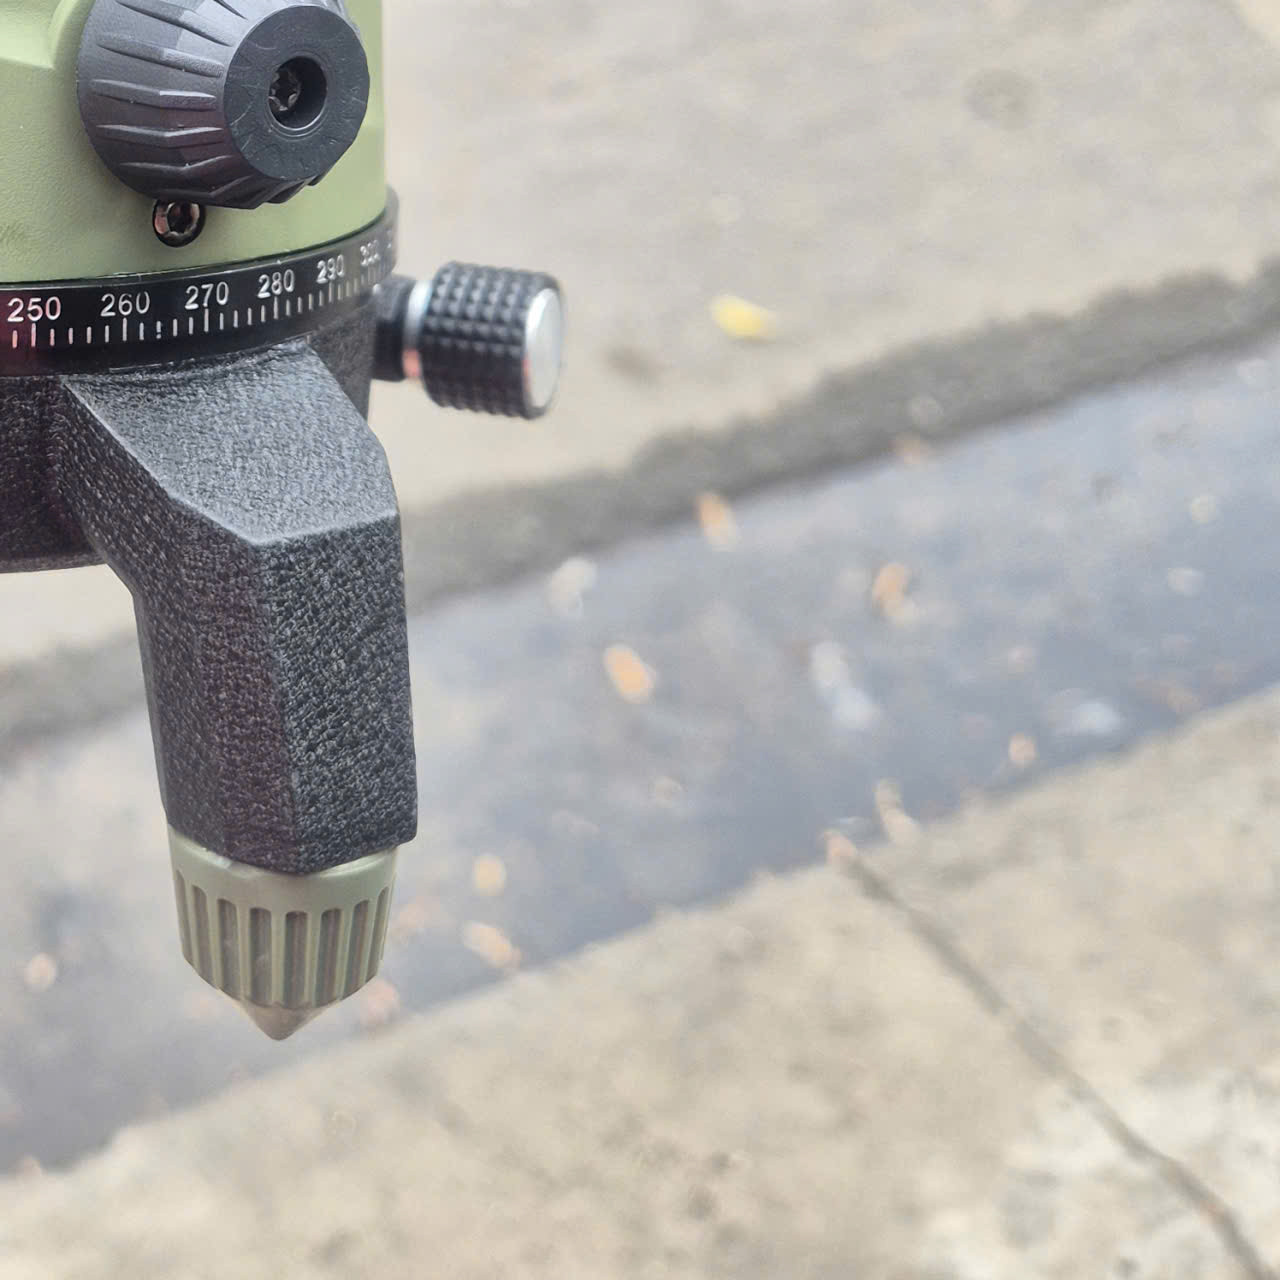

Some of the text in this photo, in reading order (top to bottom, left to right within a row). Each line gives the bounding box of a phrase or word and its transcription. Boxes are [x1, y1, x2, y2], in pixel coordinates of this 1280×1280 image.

[7, 295, 62, 324] 250
[100, 291, 151, 317] 260
[184, 281, 230, 311] 270
[257, 269, 296, 300] 280
[316, 254, 346, 285] 290
